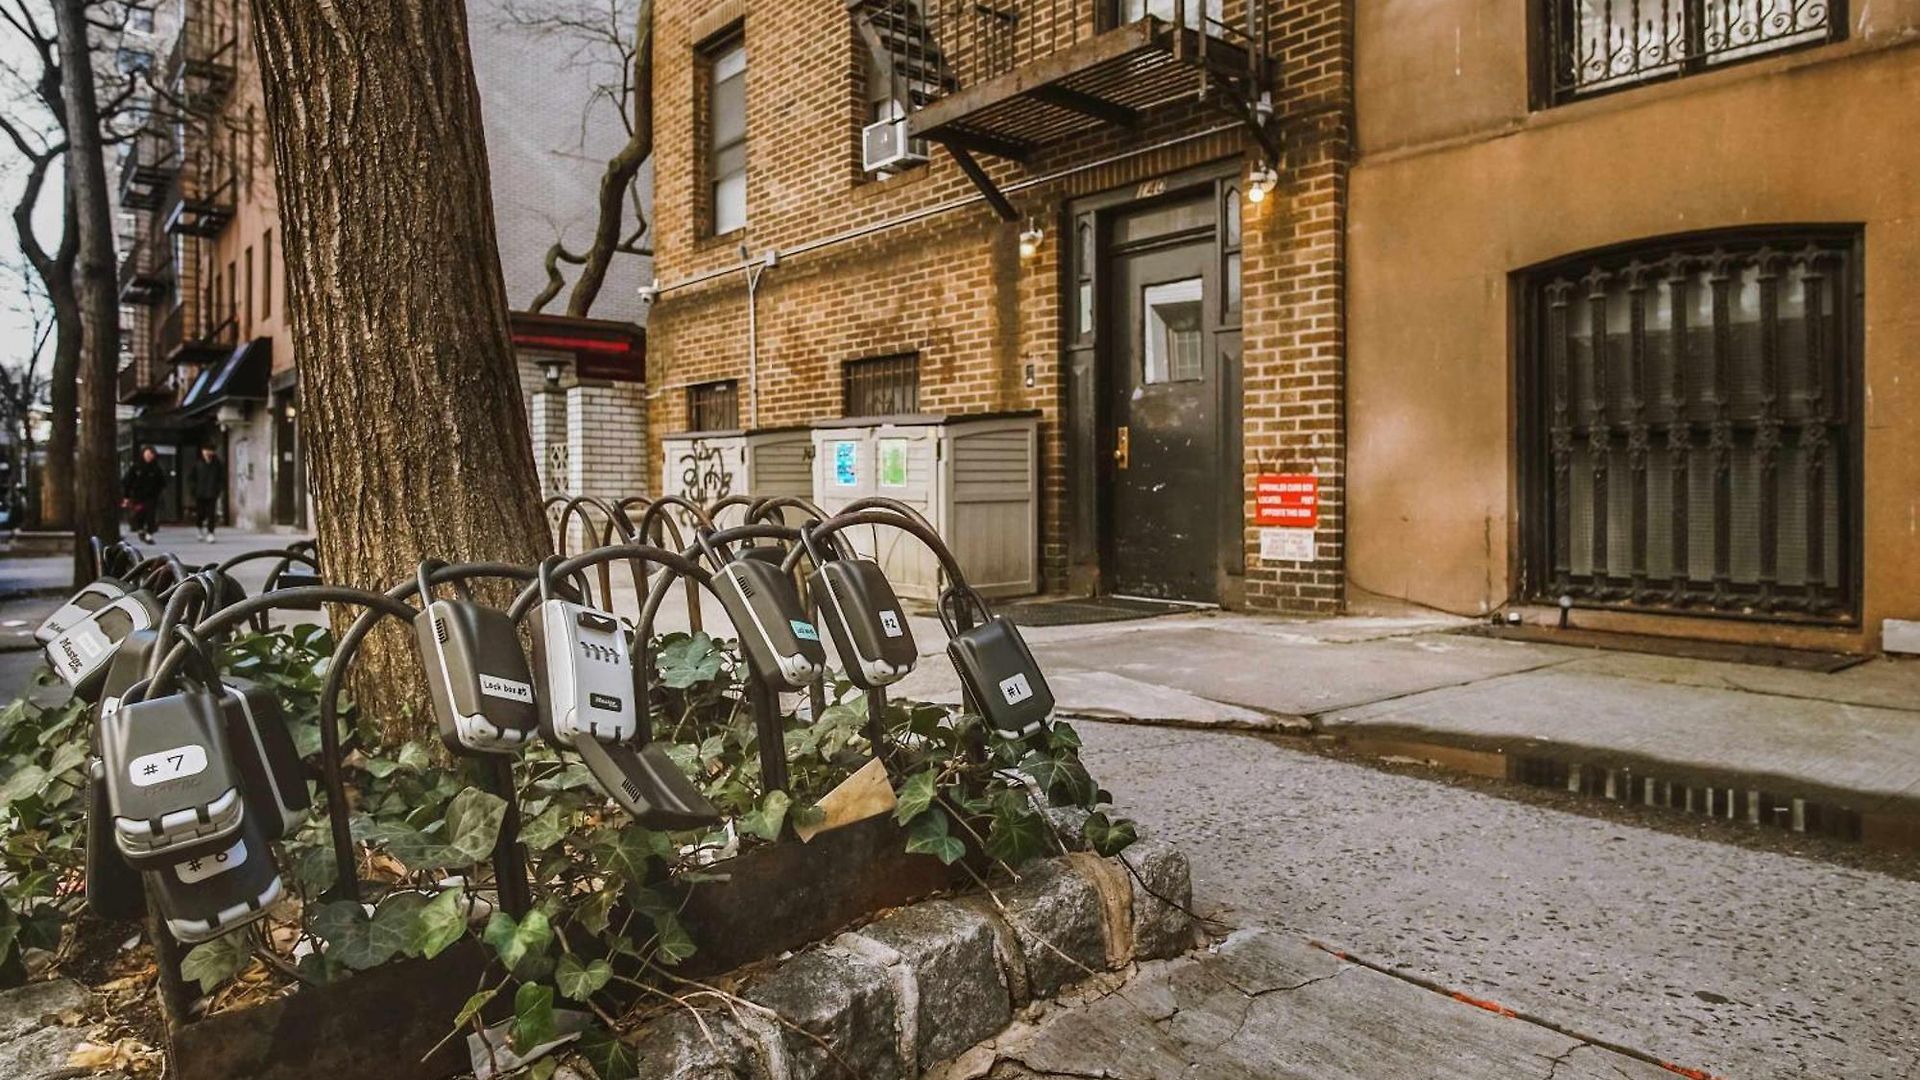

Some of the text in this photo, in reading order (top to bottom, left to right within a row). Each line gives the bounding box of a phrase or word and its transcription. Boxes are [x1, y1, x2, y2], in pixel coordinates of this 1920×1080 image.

[884, 618, 897, 628] #2
[59, 637, 83, 667] Master
[484, 680, 501, 691] Lock
[503, 683, 516, 693] box
[1007, 682, 1021, 698] #1
